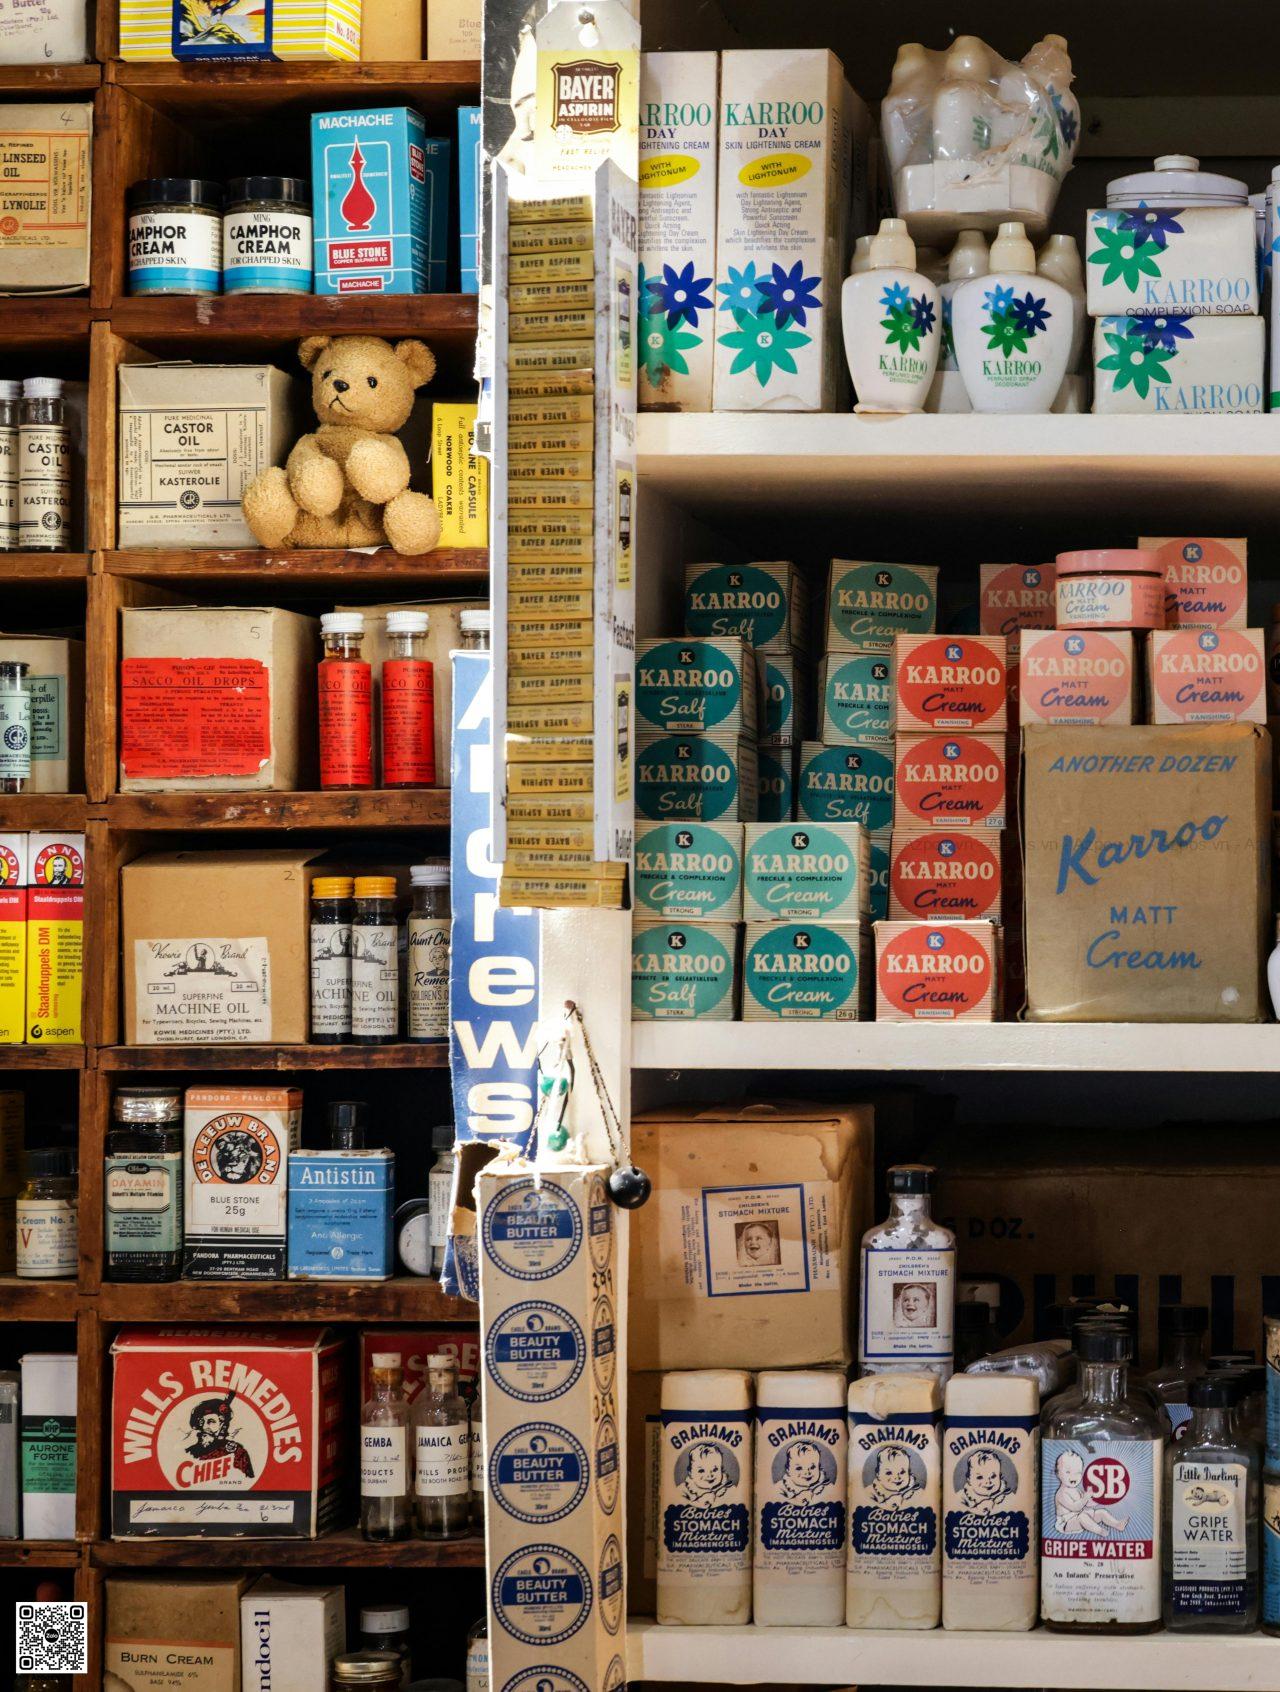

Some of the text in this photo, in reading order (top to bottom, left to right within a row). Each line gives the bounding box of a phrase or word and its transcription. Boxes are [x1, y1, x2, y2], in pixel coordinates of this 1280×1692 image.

[559, 75, 614, 99] BAYER
[559, 103, 613, 117] ASPIRIN
[725, 102, 824, 126] KARROO
[319, 114, 393, 129] MACHACHE
[759, 128, 788, 138] DAY
[747, 141, 791, 149] LIGHTENING
[4, 154, 46, 163] LINSEED
[4, 168, 20, 177] OIL
[761, 162, 782, 170] WITH
[749, 167, 797, 181] LIGHTONUM
[3, 201, 46, 210] LYNOLIE
[253, 214, 270, 222] MING
[230, 225, 301, 240] CAMPHOR
[238, 241, 290, 254] CREAM
[333, 245, 387, 259] BLUE STONE
[242, 256, 301, 266] CHAPPED SKIN
[1145, 278, 1250, 304] KARROO
[1126, 305, 1250, 316] COMPLEXION SOAP
[164, 423, 213, 433] CASTOR
[179, 436, 200, 446] OIL
[160, 477, 220, 485] KASTEROLIE
[468, 476, 476, 519] CAPSULE
[691, 592, 780, 610] KARROO
[711, 618, 755, 640] Salf
[132, 677, 255, 686] SACCO OIL DROPS
[907, 666, 1001, 685] KARROO
[922, 694, 985, 713] Cream
[1049, 755, 1237, 773] ANOTHER DOZEN
[1056, 814, 1228, 894] Karroo
[37, 846, 82, 878] LENNON
[752, 854, 849, 873] KARROO
[1110, 906, 1178, 924] MATT
[152, 943, 248, 959] Kowie Brand
[1087, 931, 1202, 970] Cream
[38, 928, 52, 1018] Staaldruppels DM
[156, 1003, 249, 1014] MACHINE OIL
[45, 1028, 74, 1040] aspen
[196, 1116, 278, 1183] DE LEEUW BRAND
[112, 1178, 164, 1188] DAYAMIN
[300, 1167, 375, 1185] Antistin
[225, 1206, 245, 1216] 25g
[510, 1336, 560, 1347] BEAUTY
[510, 1349, 560, 1360] BUTTER
[123, 1360, 302, 1464] WILLS REMEDIES
[365, 1438, 392, 1447] GEMBA
[418, 1437, 451, 1447] JAMAICA
[670, 1422, 743, 1450] GRAHAM'S
[29, 1444, 74, 1453] AURONE
[34, 1453, 69, 1461] FORTE
[176, 1455, 233, 1488] CHIEF
[1176, 1465, 1239, 1487] Little Darling
[1086, 1465, 1128, 1499] SB
[683, 1506, 731, 1519] Babies
[679, 1531, 734, 1542] Mixture
[1045, 1541, 1145, 1557] GRIPE WATER
[120, 1652, 214, 1665] BURN CREAM
